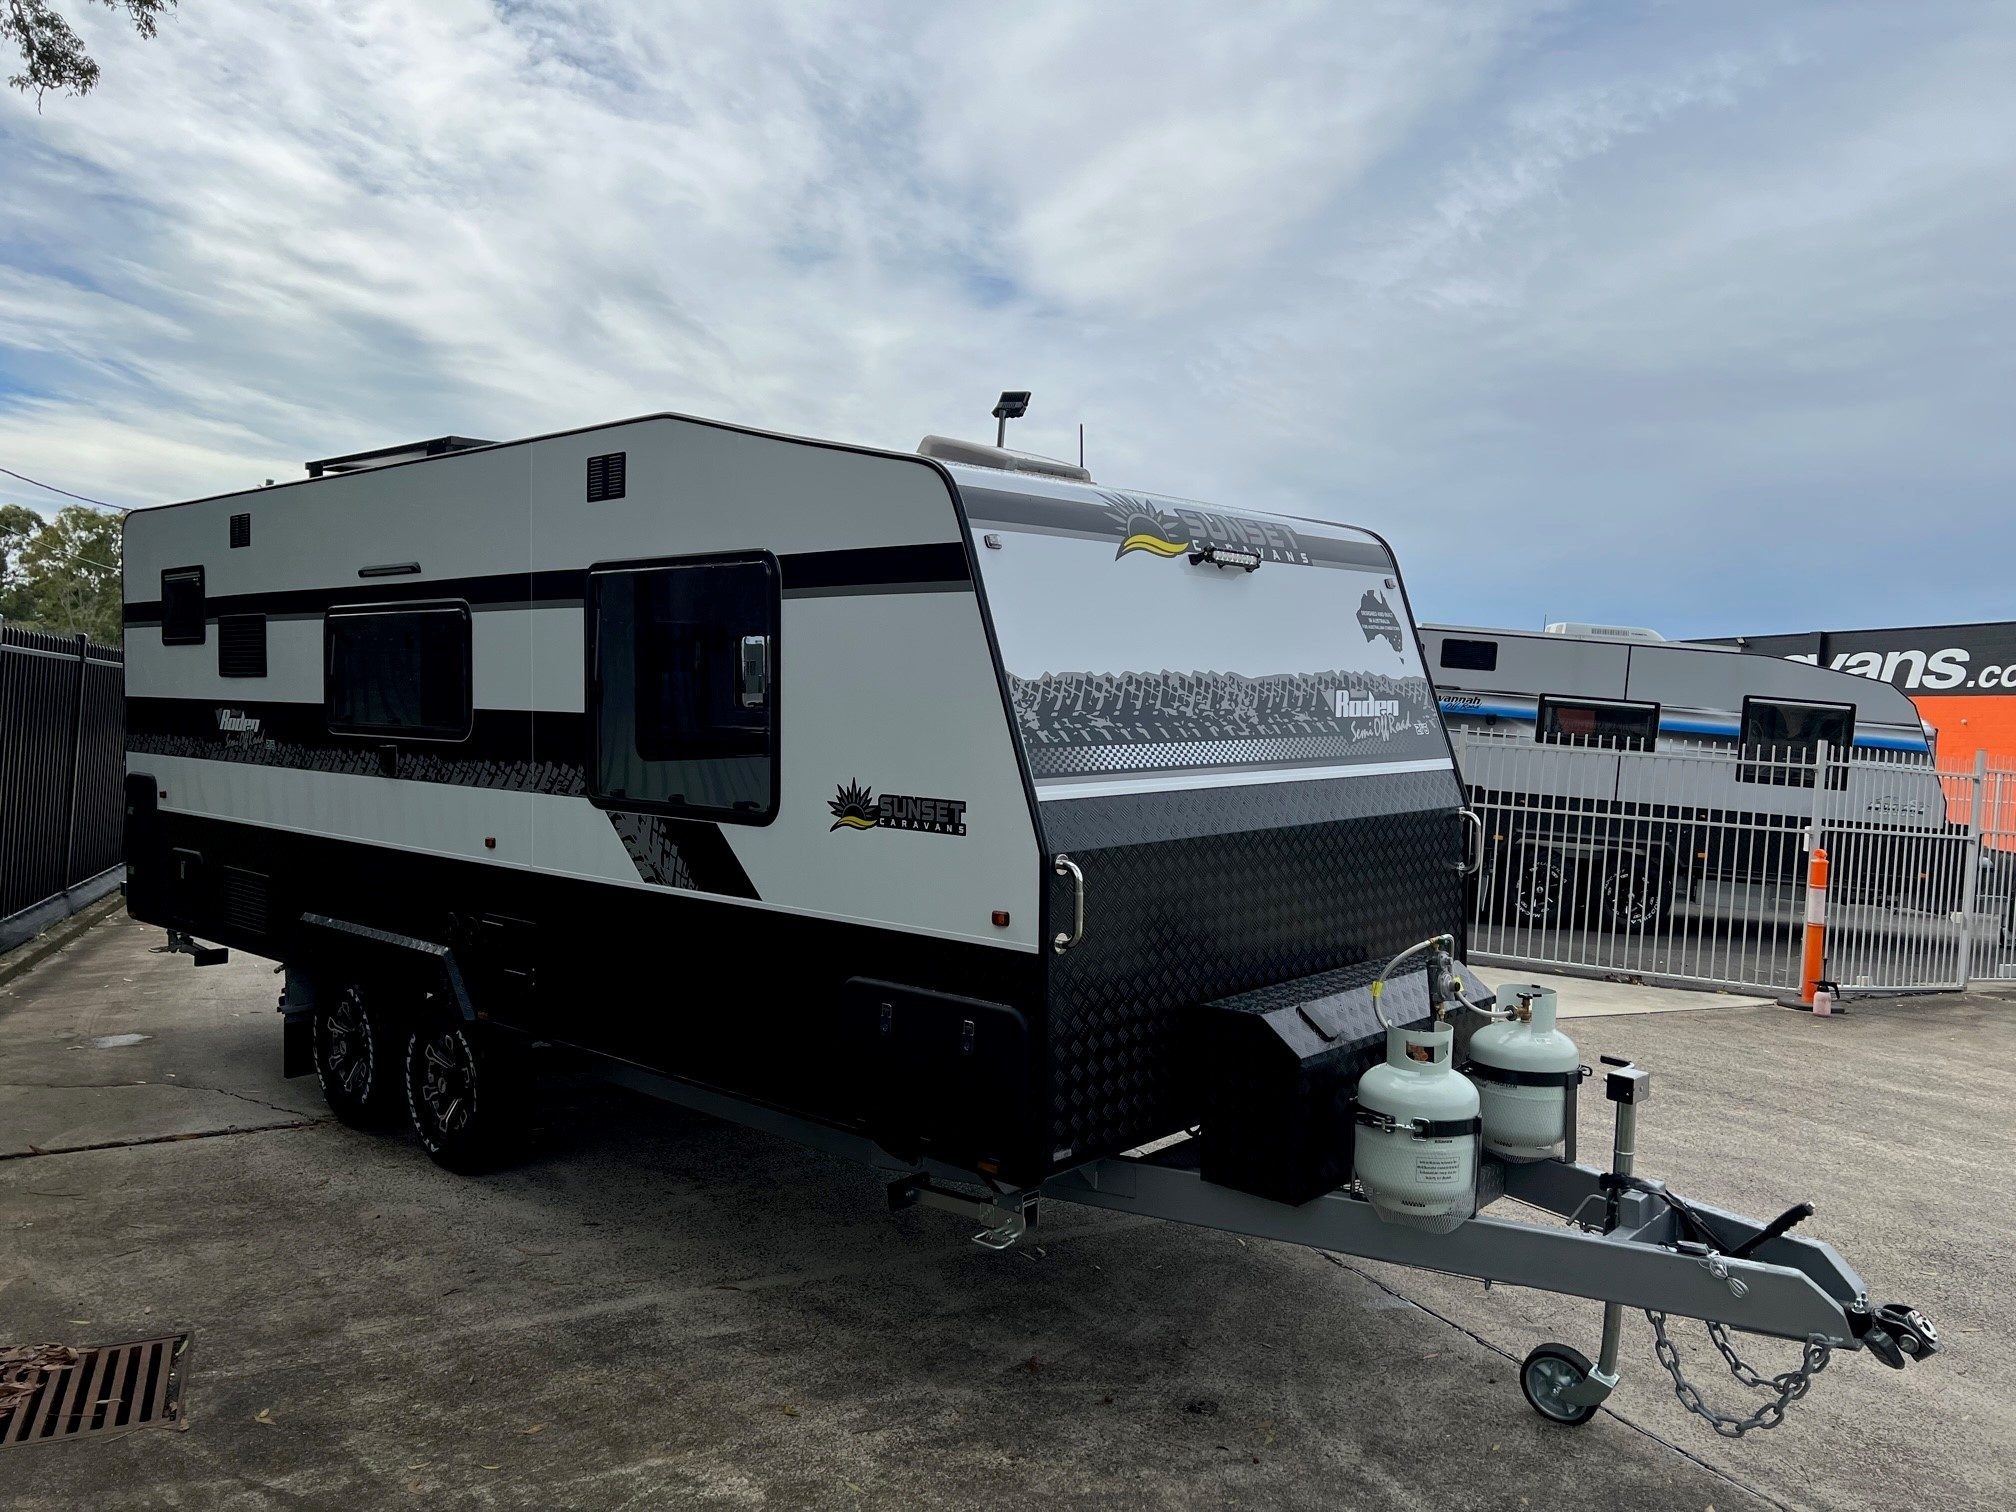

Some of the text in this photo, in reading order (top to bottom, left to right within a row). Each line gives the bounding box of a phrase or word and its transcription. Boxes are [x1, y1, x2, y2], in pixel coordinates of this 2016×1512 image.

[1175, 509, 1299, 549] SUNSET
[1335, 690, 1399, 717] Roden
[219, 709, 260, 732] Roden
[879, 796, 965, 824] SUNSET
[879, 817, 964, 834] CARAVANS
